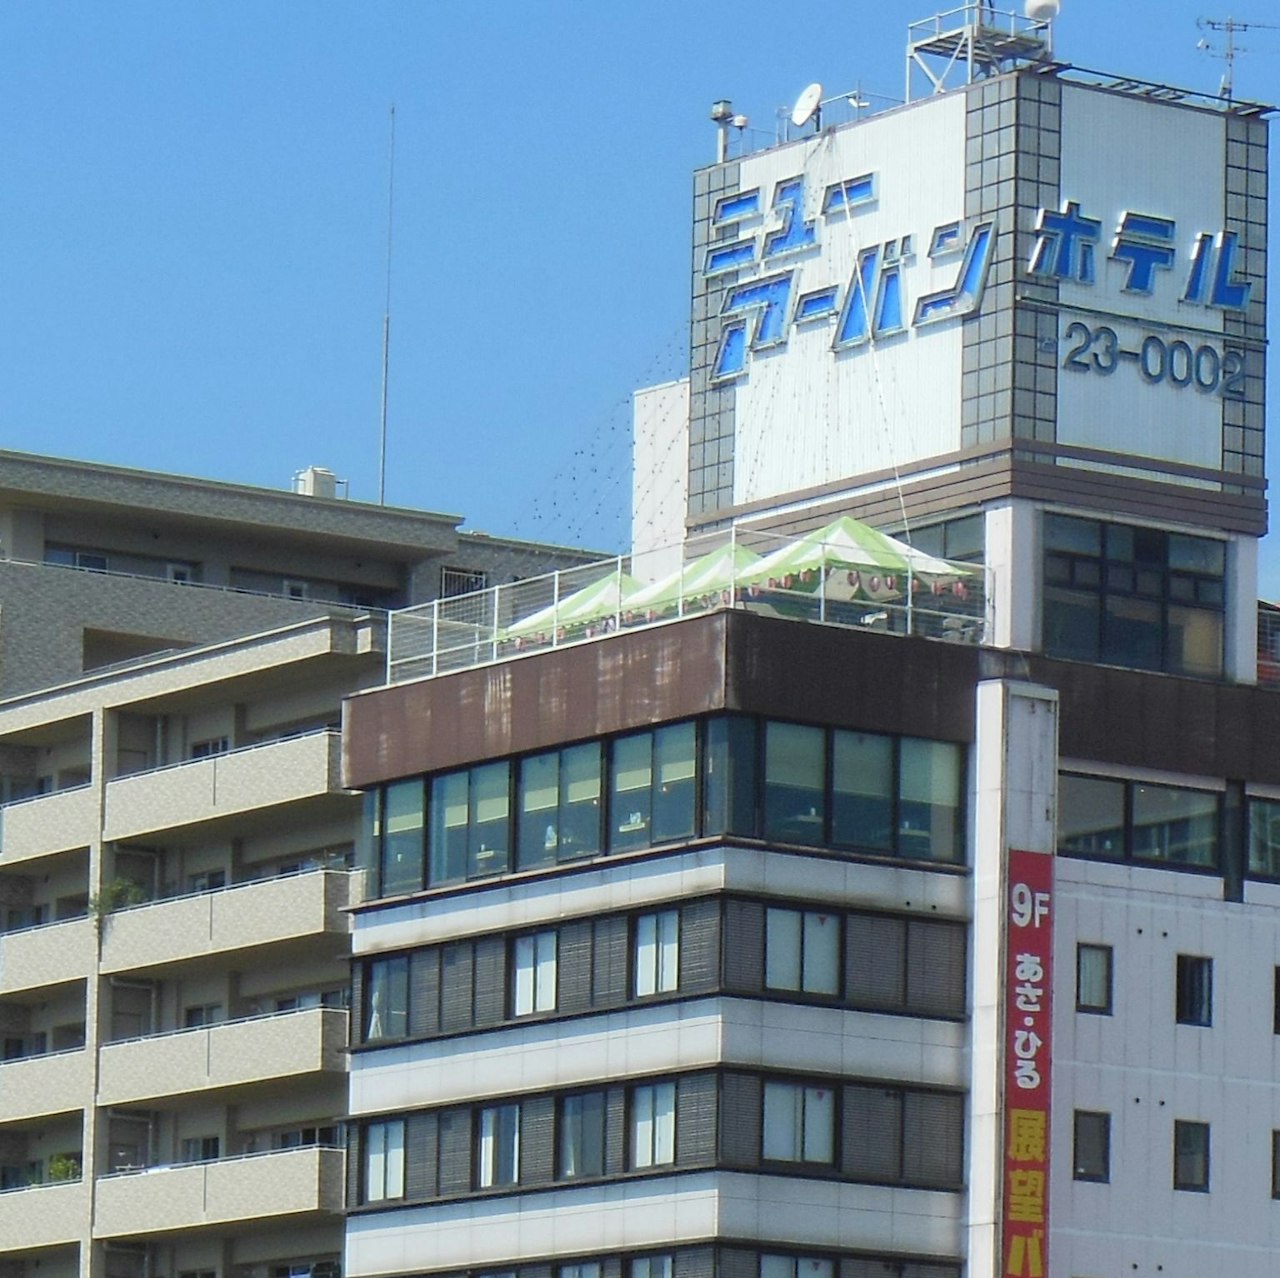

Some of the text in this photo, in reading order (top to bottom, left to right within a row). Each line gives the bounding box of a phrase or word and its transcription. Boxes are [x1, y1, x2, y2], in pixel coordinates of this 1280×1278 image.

[702, 171, 879, 279] ニュー
[1027, 200, 1252, 312] ホテル
[709, 218, 998, 384] アーバン
[1063, 321, 1247, 400] 23-0002
[1011, 882, 1051, 929] 9F
[1014, 952, 1044, 1090] あさ・ひる
